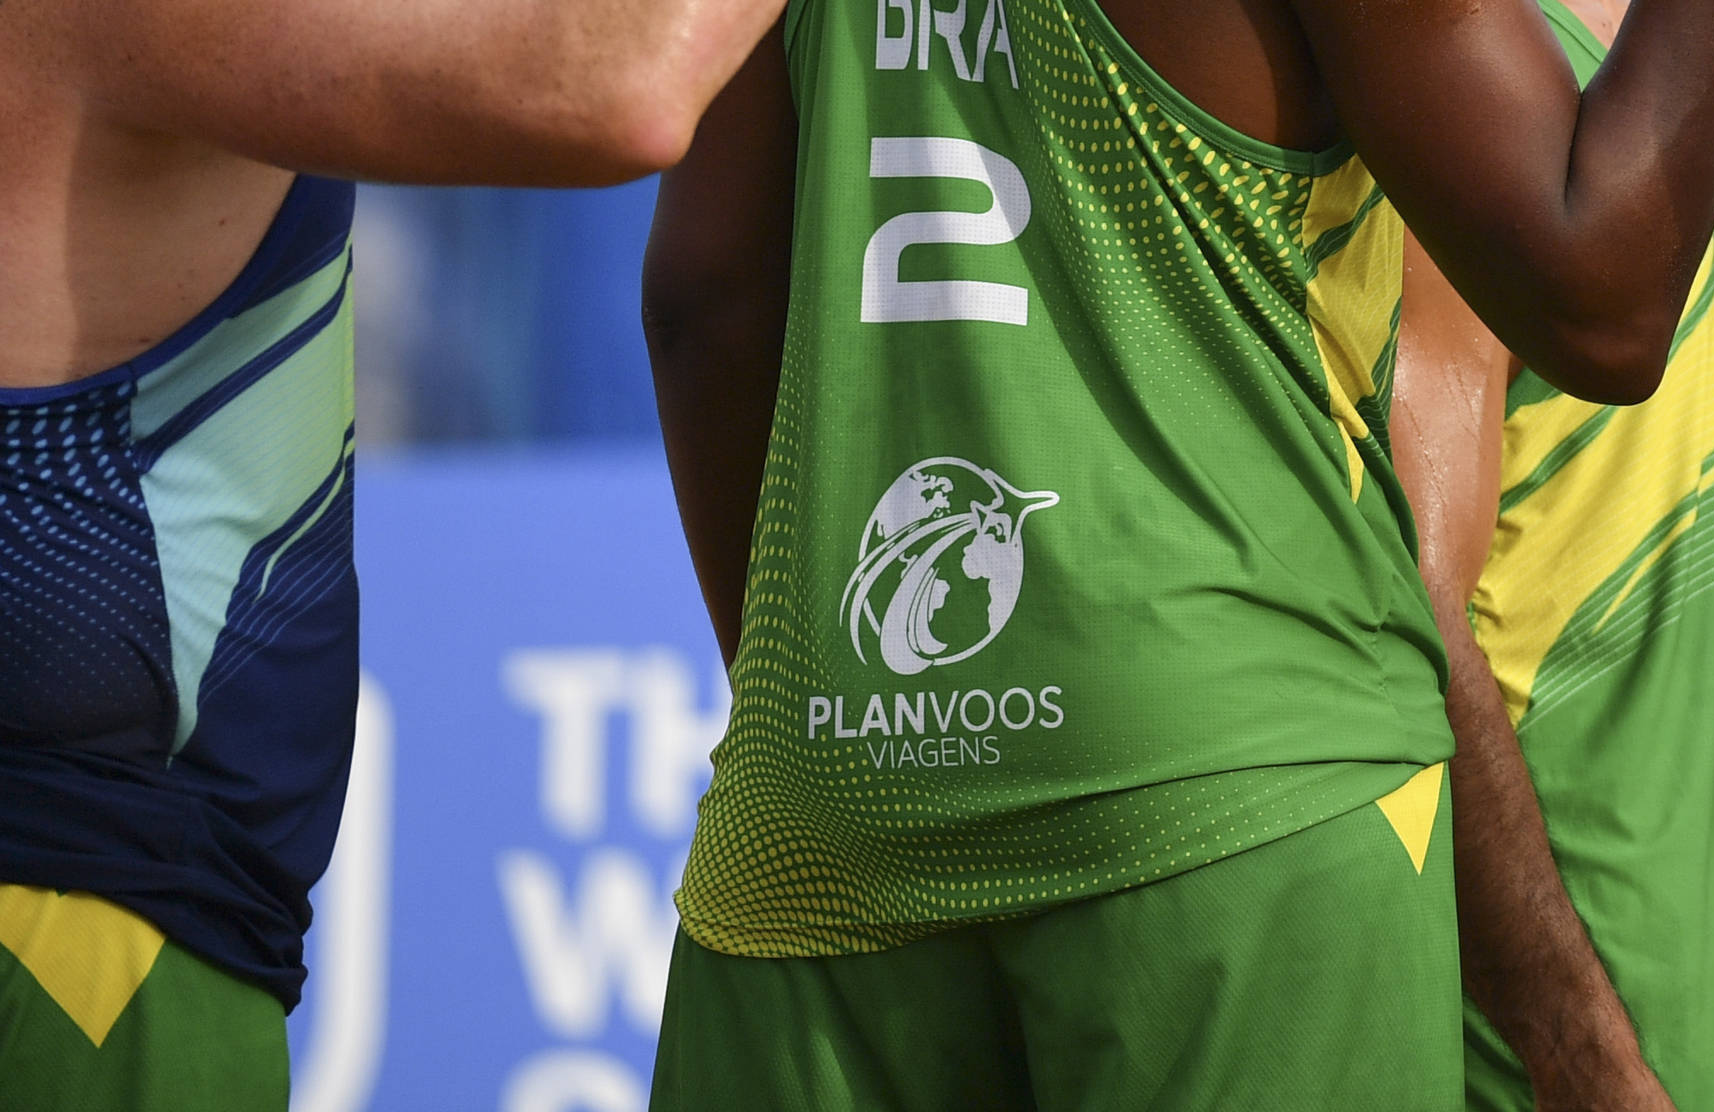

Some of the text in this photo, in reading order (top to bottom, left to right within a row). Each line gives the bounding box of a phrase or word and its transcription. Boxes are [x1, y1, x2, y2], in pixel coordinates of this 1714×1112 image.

[860, 137, 1031, 325] 2
[807, 685, 1064, 740] PLANVOOS
[867, 736, 1000, 769] VIAGENS
